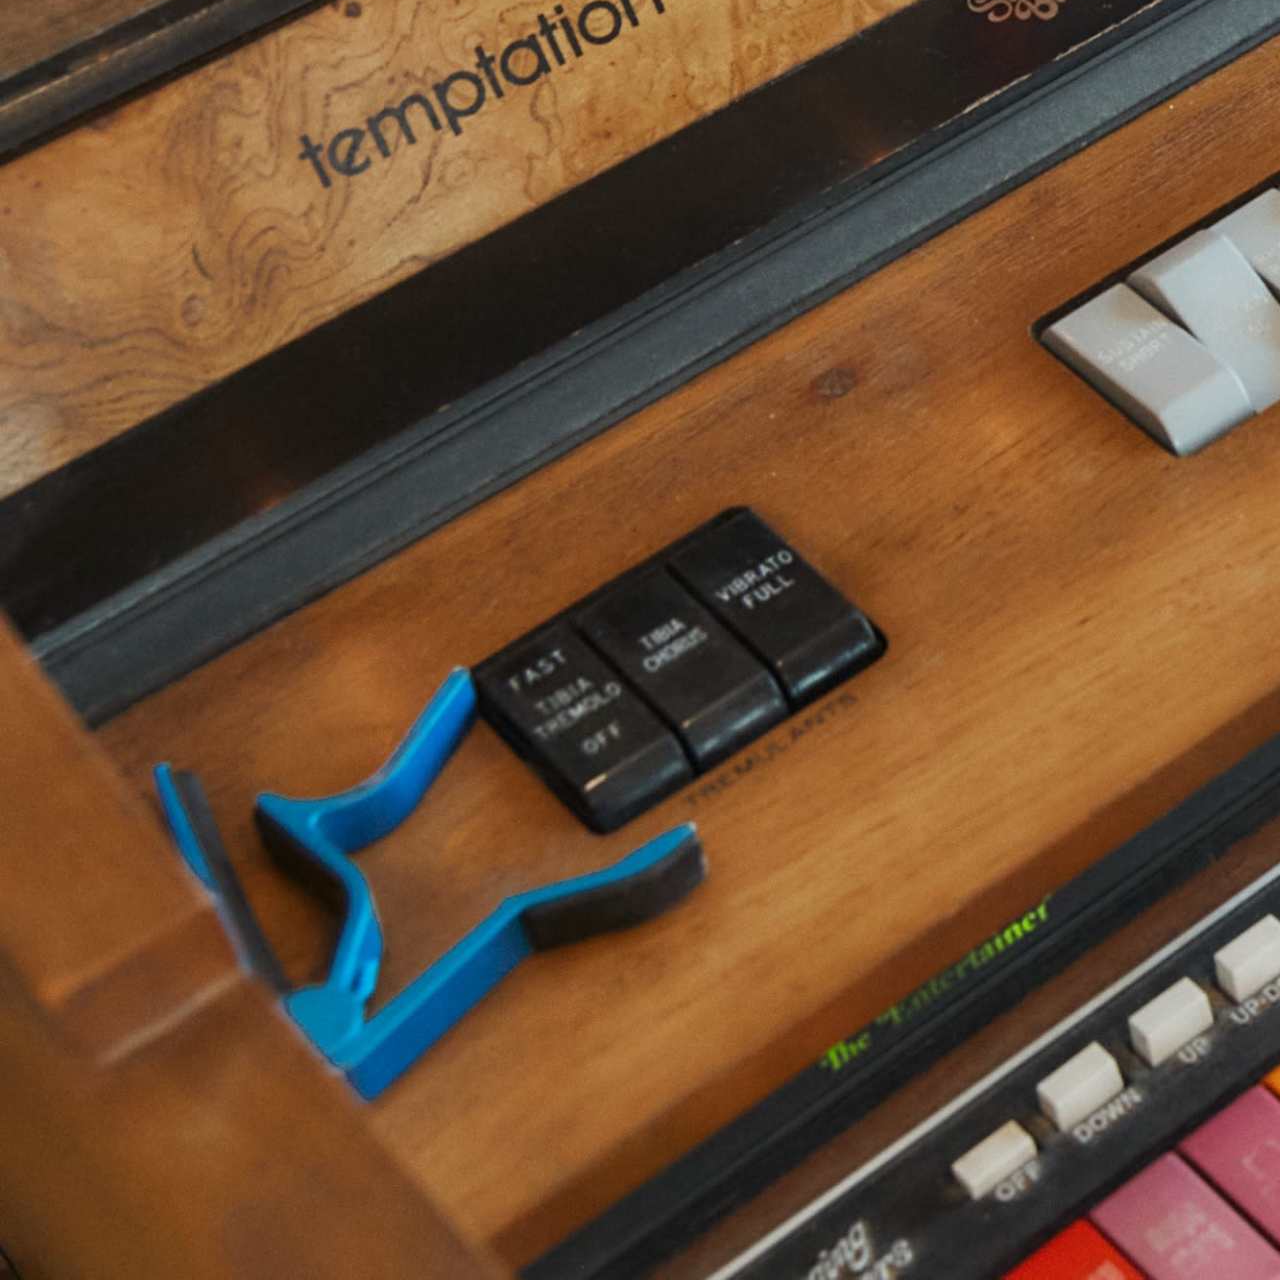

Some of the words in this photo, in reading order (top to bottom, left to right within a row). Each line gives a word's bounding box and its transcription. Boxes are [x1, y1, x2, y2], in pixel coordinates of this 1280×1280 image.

[714, 549, 794, 603] VIBRATO
[742, 572, 797, 610] FULL
[639, 617, 687, 651] TIBIA
[508, 648, 567, 693] FAST
[534, 676, 595, 717] TIBIA
[581, 722, 622, 757] OFF
[816, 1032, 872, 1072] The
[1177, 1037, 1212, 1065] UP
[1072, 1086, 1143, 1144] DOWN
[994, 1159, 1041, 1203] OFF
